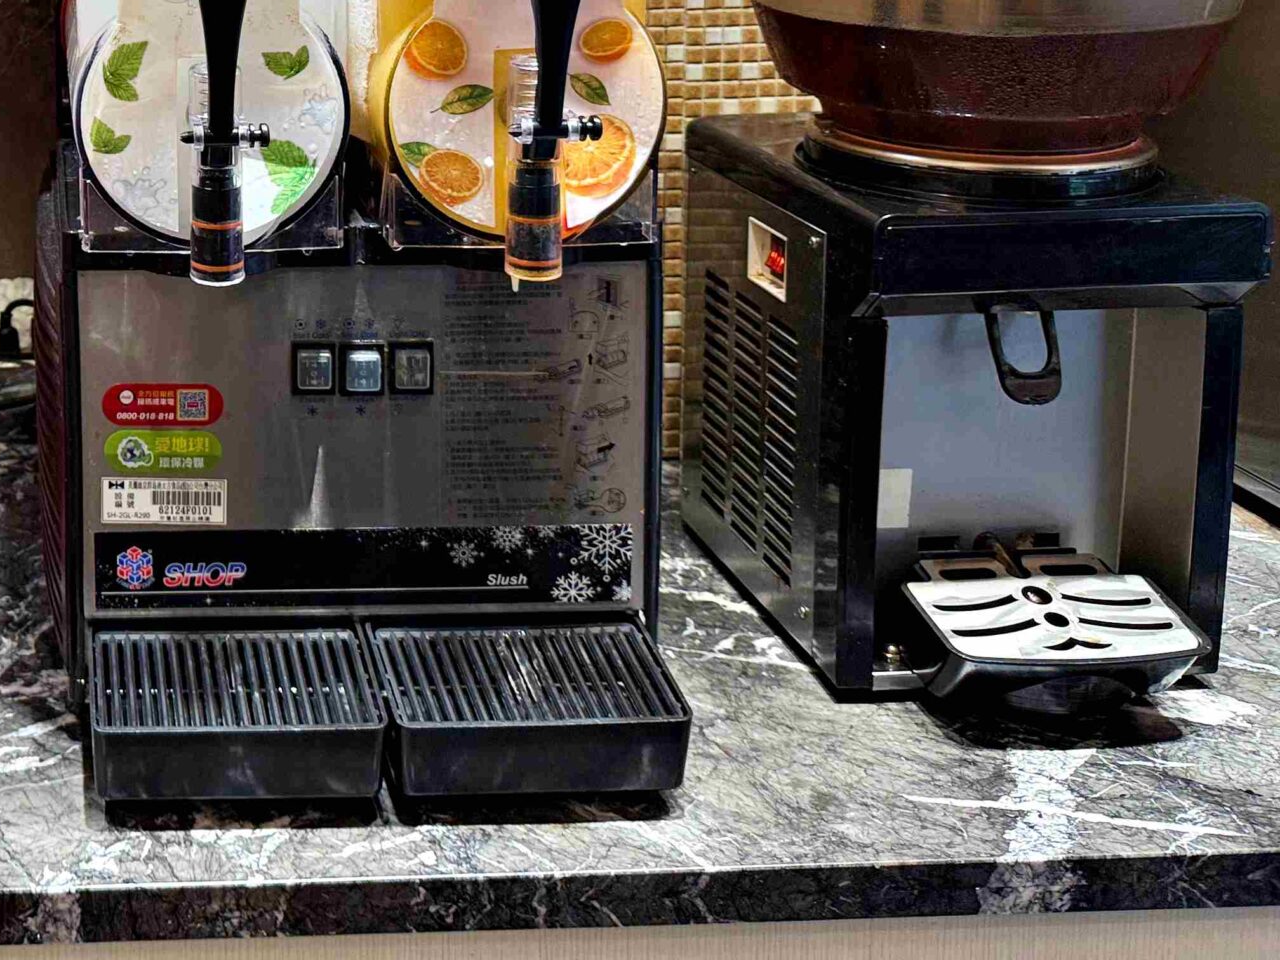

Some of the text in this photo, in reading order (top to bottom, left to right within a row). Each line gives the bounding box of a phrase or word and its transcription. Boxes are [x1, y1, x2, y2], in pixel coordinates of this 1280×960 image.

[159, 506, 212, 515] 62124F0101
[163, 562, 247, 587] SHOP
[487, 573, 528, 586] Slush
